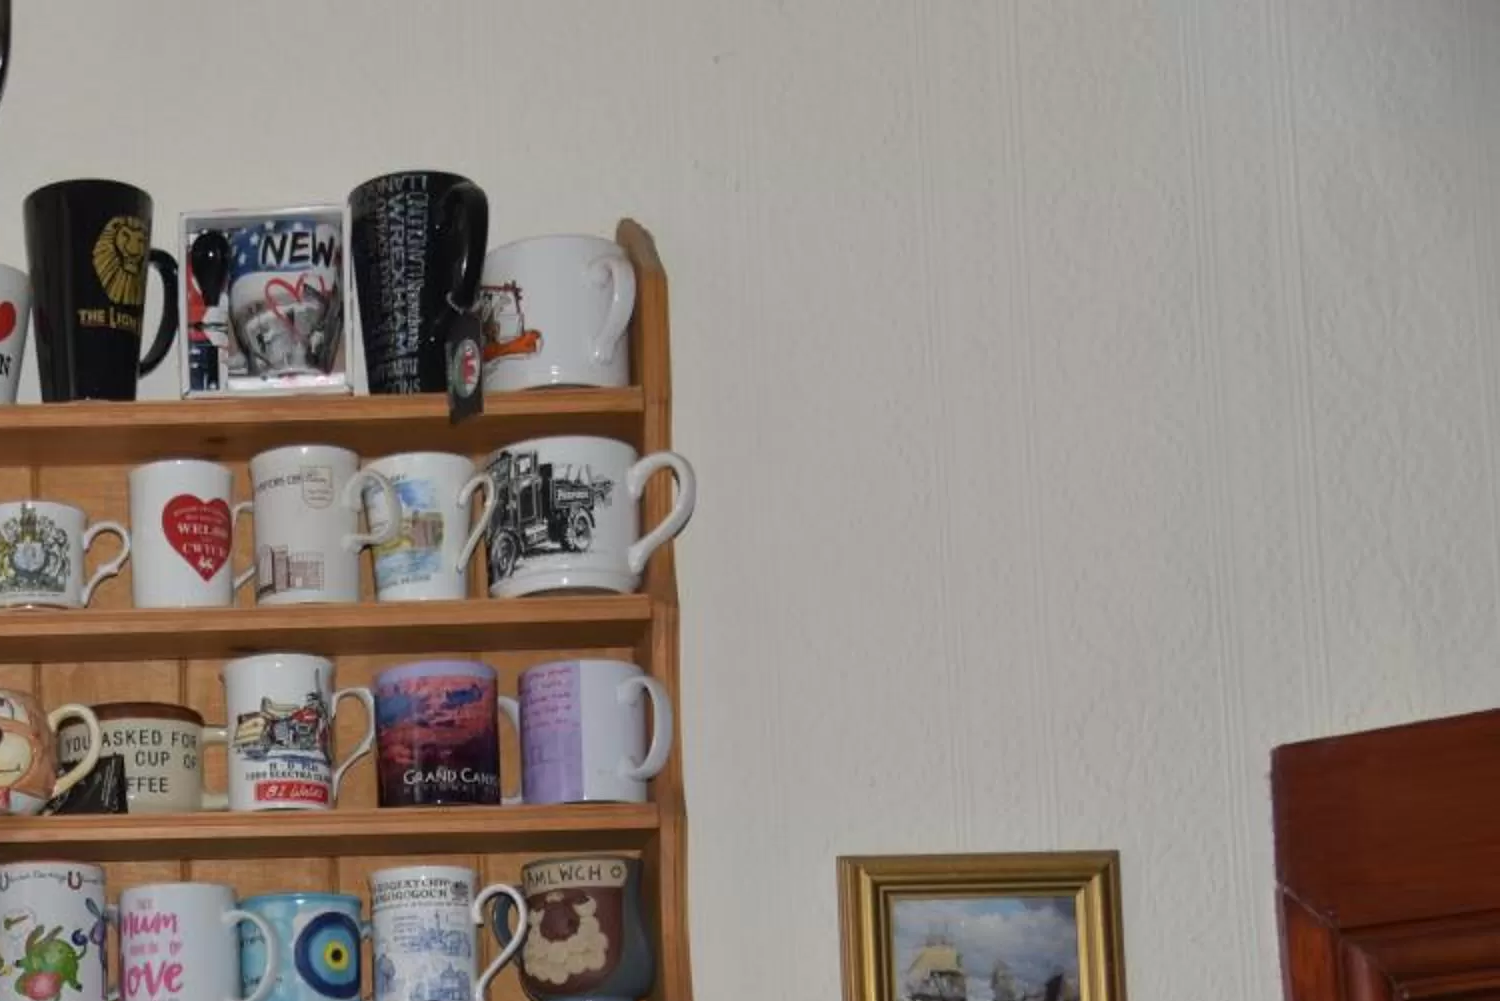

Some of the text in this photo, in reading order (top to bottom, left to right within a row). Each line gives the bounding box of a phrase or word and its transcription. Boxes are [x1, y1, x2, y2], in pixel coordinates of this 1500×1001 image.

[259, 231, 337, 268] NEW
[77, 309, 106, 326] THE
[101, 730, 164, 749] ASKED
[135, 750, 172, 768] CUP
[125, 777, 169, 794] FFEE
[403, 768, 457, 786] GRAND
